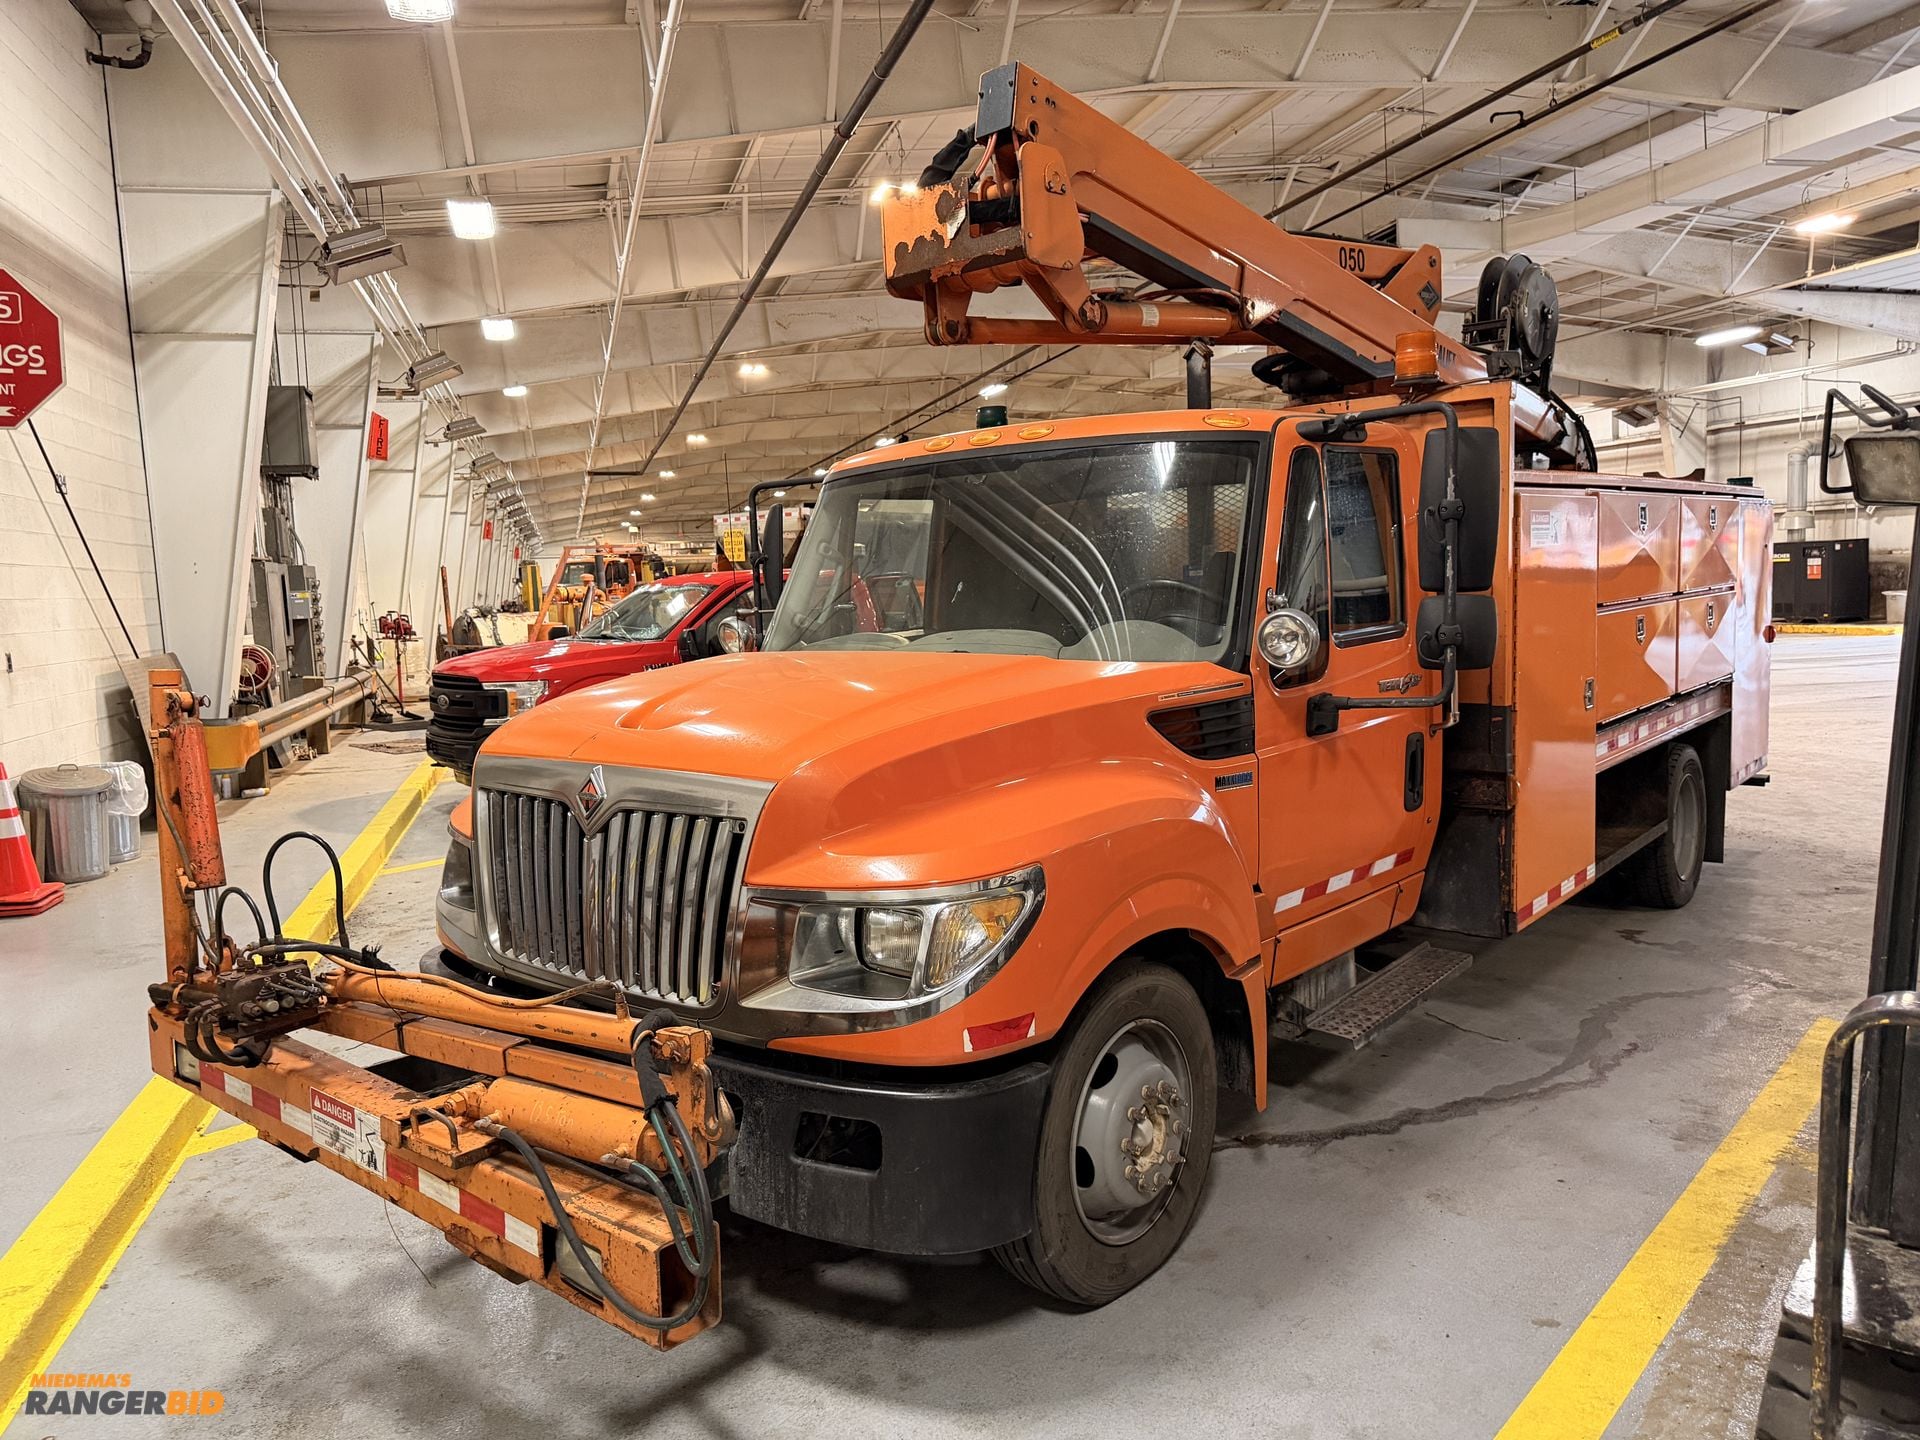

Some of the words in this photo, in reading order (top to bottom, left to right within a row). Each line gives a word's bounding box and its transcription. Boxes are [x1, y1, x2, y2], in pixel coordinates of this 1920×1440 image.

[1339, 246, 1365, 272] 050
[0, 344, 46, 368] GS
[376, 419, 385, 456] FIRE
[321, 1099, 353, 1124] DANGER
